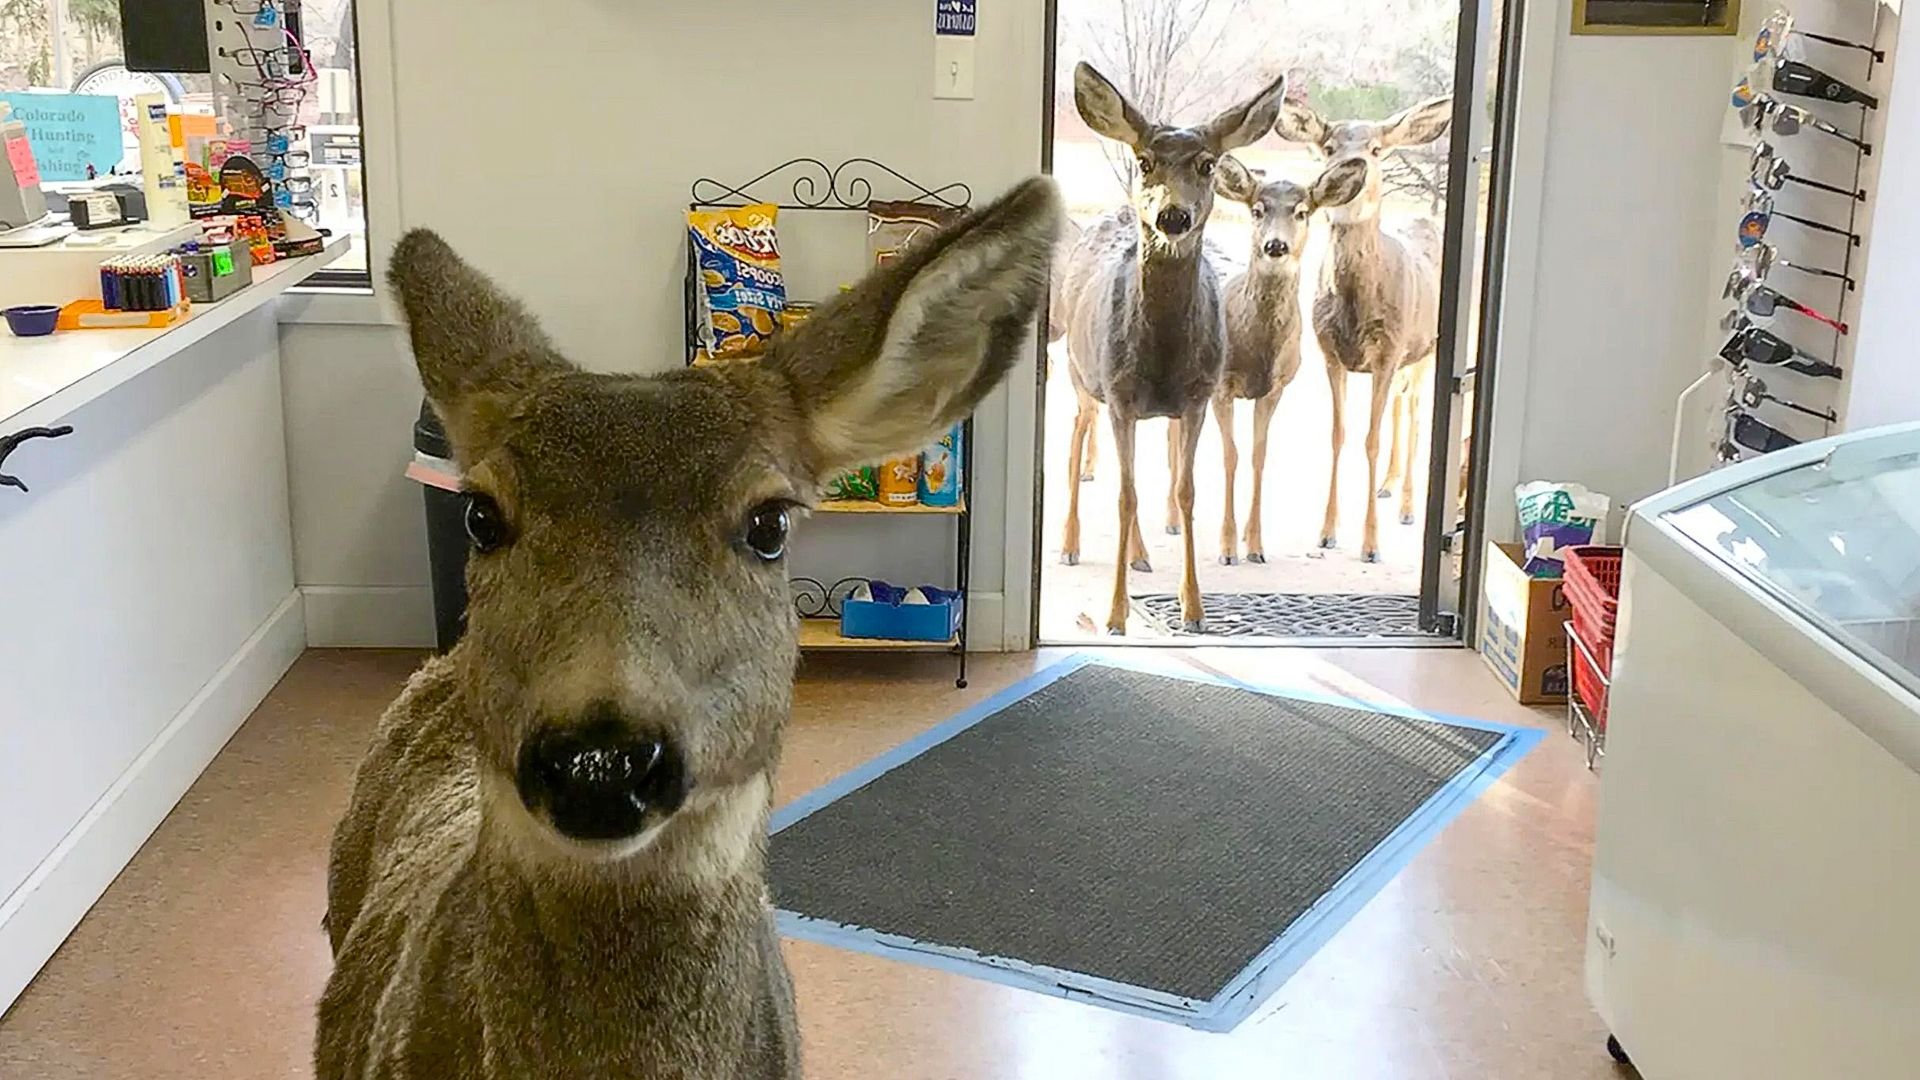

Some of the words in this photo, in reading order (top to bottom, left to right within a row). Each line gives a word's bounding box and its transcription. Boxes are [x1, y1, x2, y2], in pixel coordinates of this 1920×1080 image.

[13, 107, 85, 122] Colorado
[31, 128, 95, 143] Hunting
[37, 159, 84, 174] ishing
